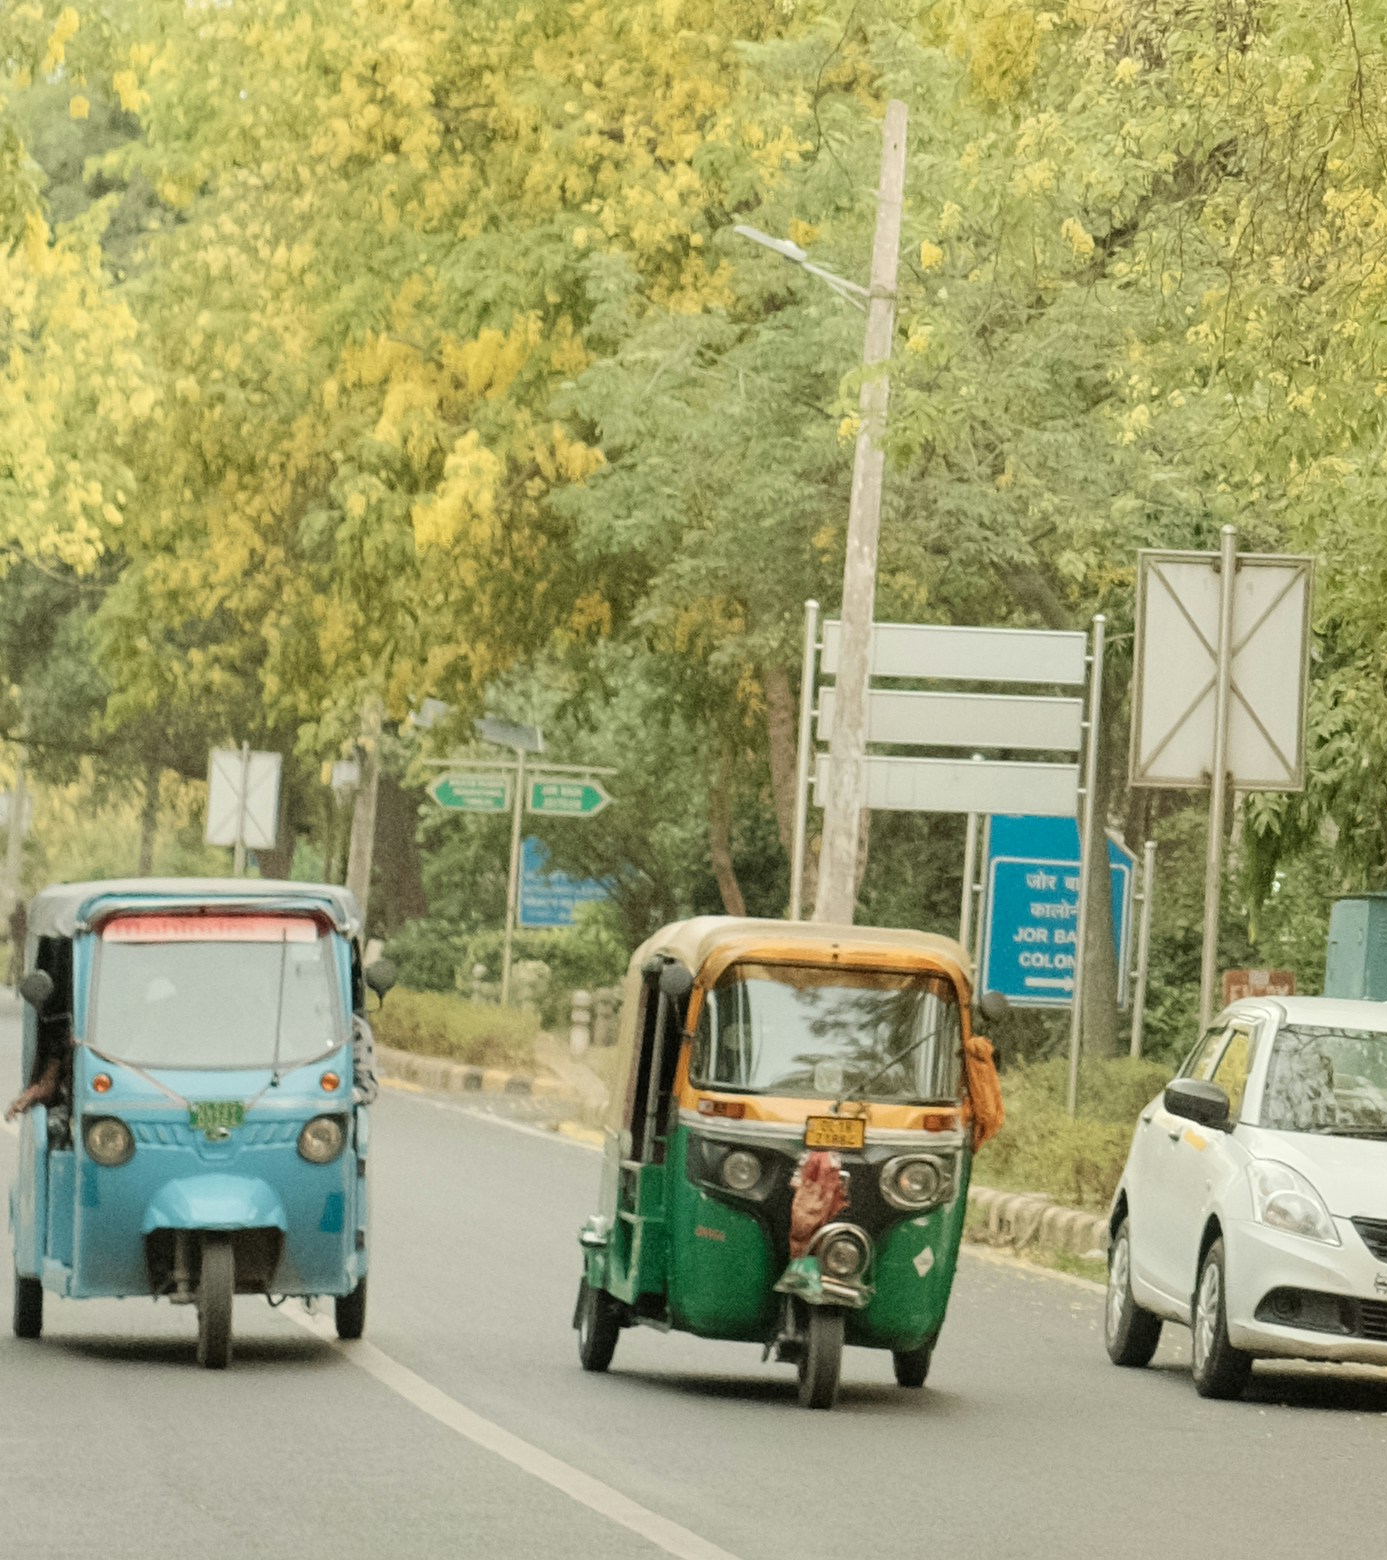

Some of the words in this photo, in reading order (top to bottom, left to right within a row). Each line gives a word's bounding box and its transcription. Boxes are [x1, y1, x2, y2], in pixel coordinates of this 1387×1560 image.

[1026, 870, 1057, 890] जोर
[1013, 927, 1048, 943] JOR
[1019, 952, 1074, 969] COLON
